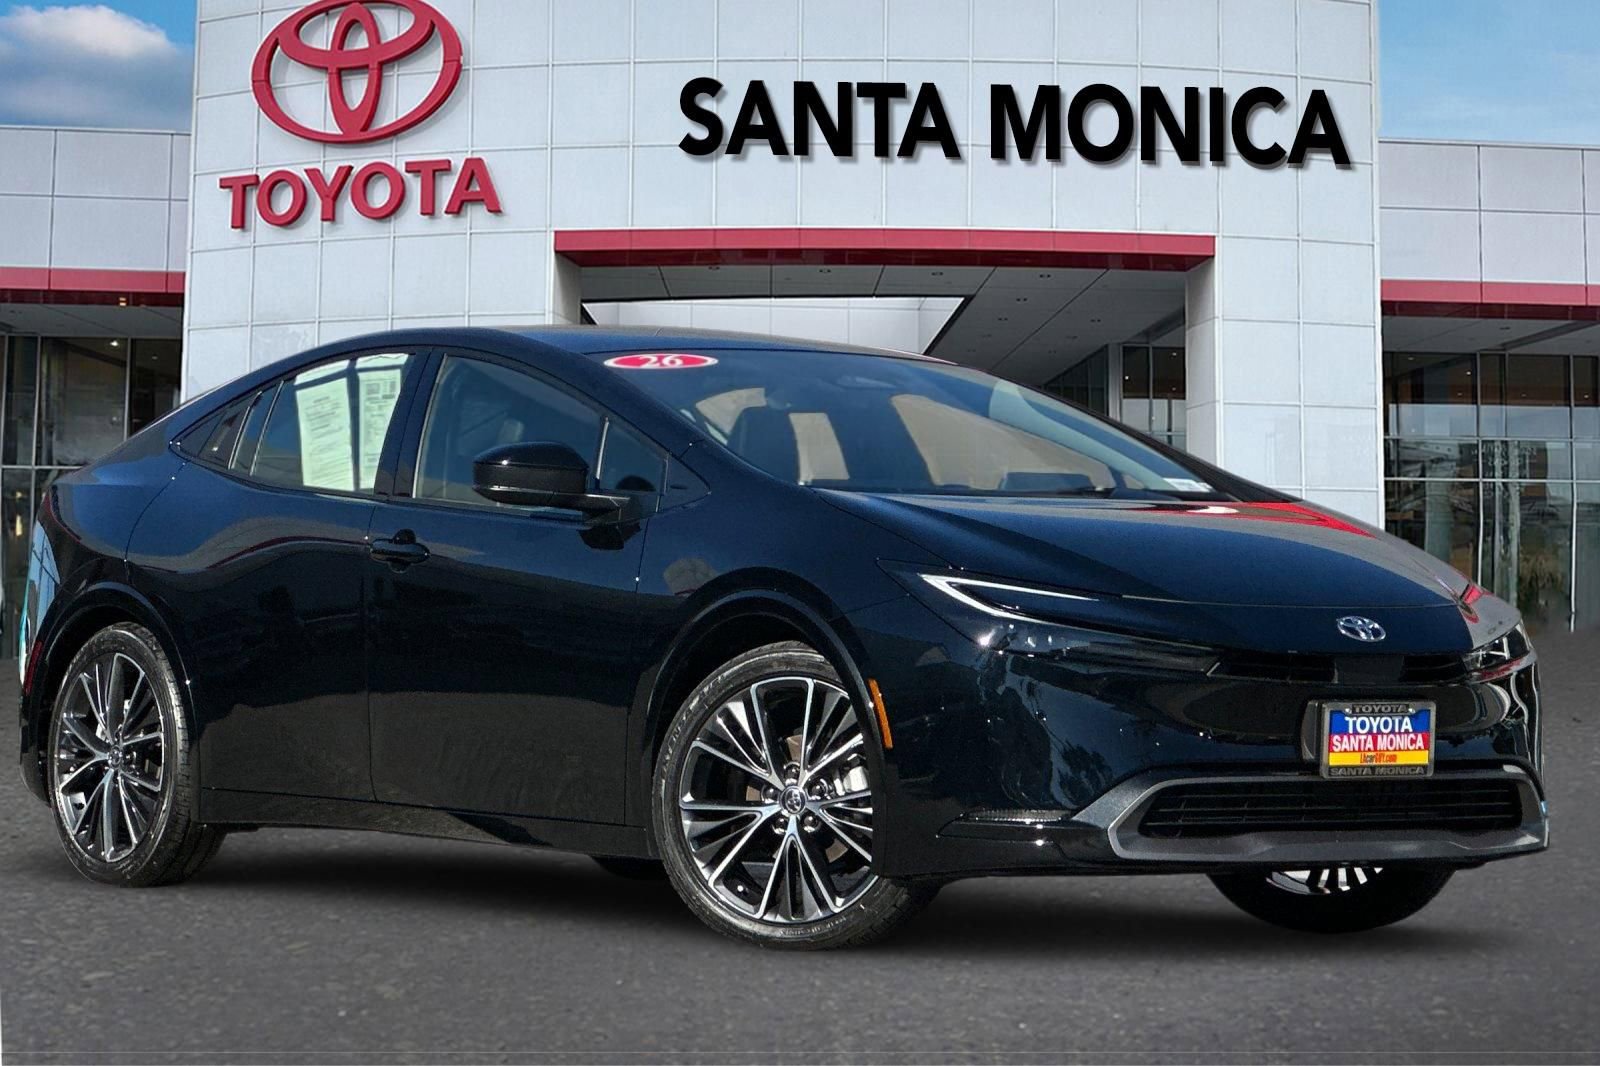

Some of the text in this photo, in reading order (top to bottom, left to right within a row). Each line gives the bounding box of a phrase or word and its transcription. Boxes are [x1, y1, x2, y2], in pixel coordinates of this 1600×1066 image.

[678, 77, 1351, 168] SANTA MONICA
[219, 157, 503, 230] TOYOTA
[640, 354, 685, 367] 26
[1353, 703, 1408, 713] TOYOTA
[1345, 716, 1412, 733] TOYOTA
[1332, 733, 1424, 752] SANTA MONICA
[1330, 766, 1424, 776] SANTA MONICA
